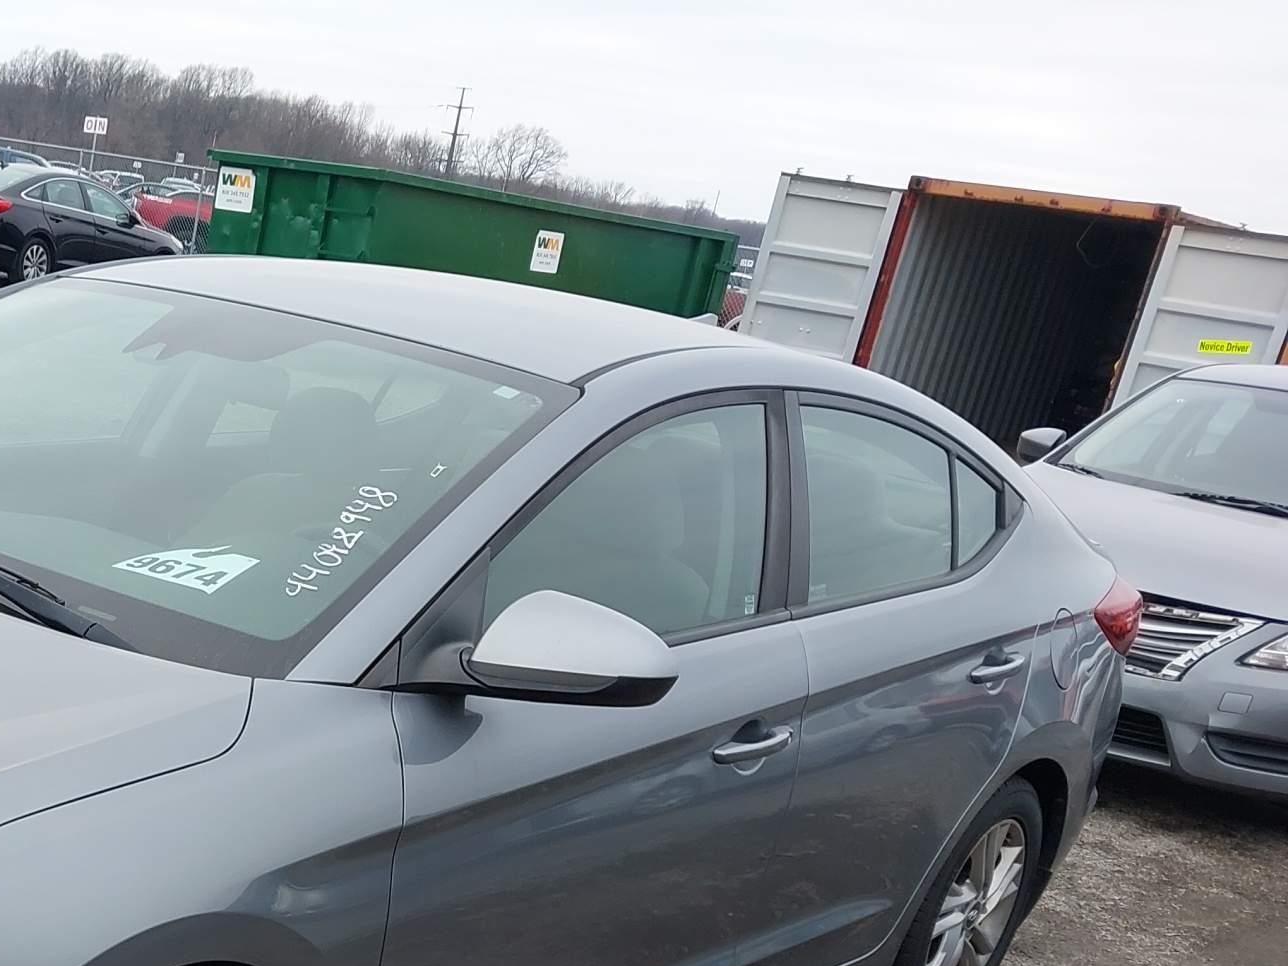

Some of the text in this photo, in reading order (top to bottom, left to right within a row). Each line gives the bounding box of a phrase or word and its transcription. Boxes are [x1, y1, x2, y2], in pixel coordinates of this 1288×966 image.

[221, 172, 251, 189] WM
[537, 236, 560, 251] WM
[1199, 341, 1250, 353] Novice Driver
[125, 556, 230, 587] 9674
